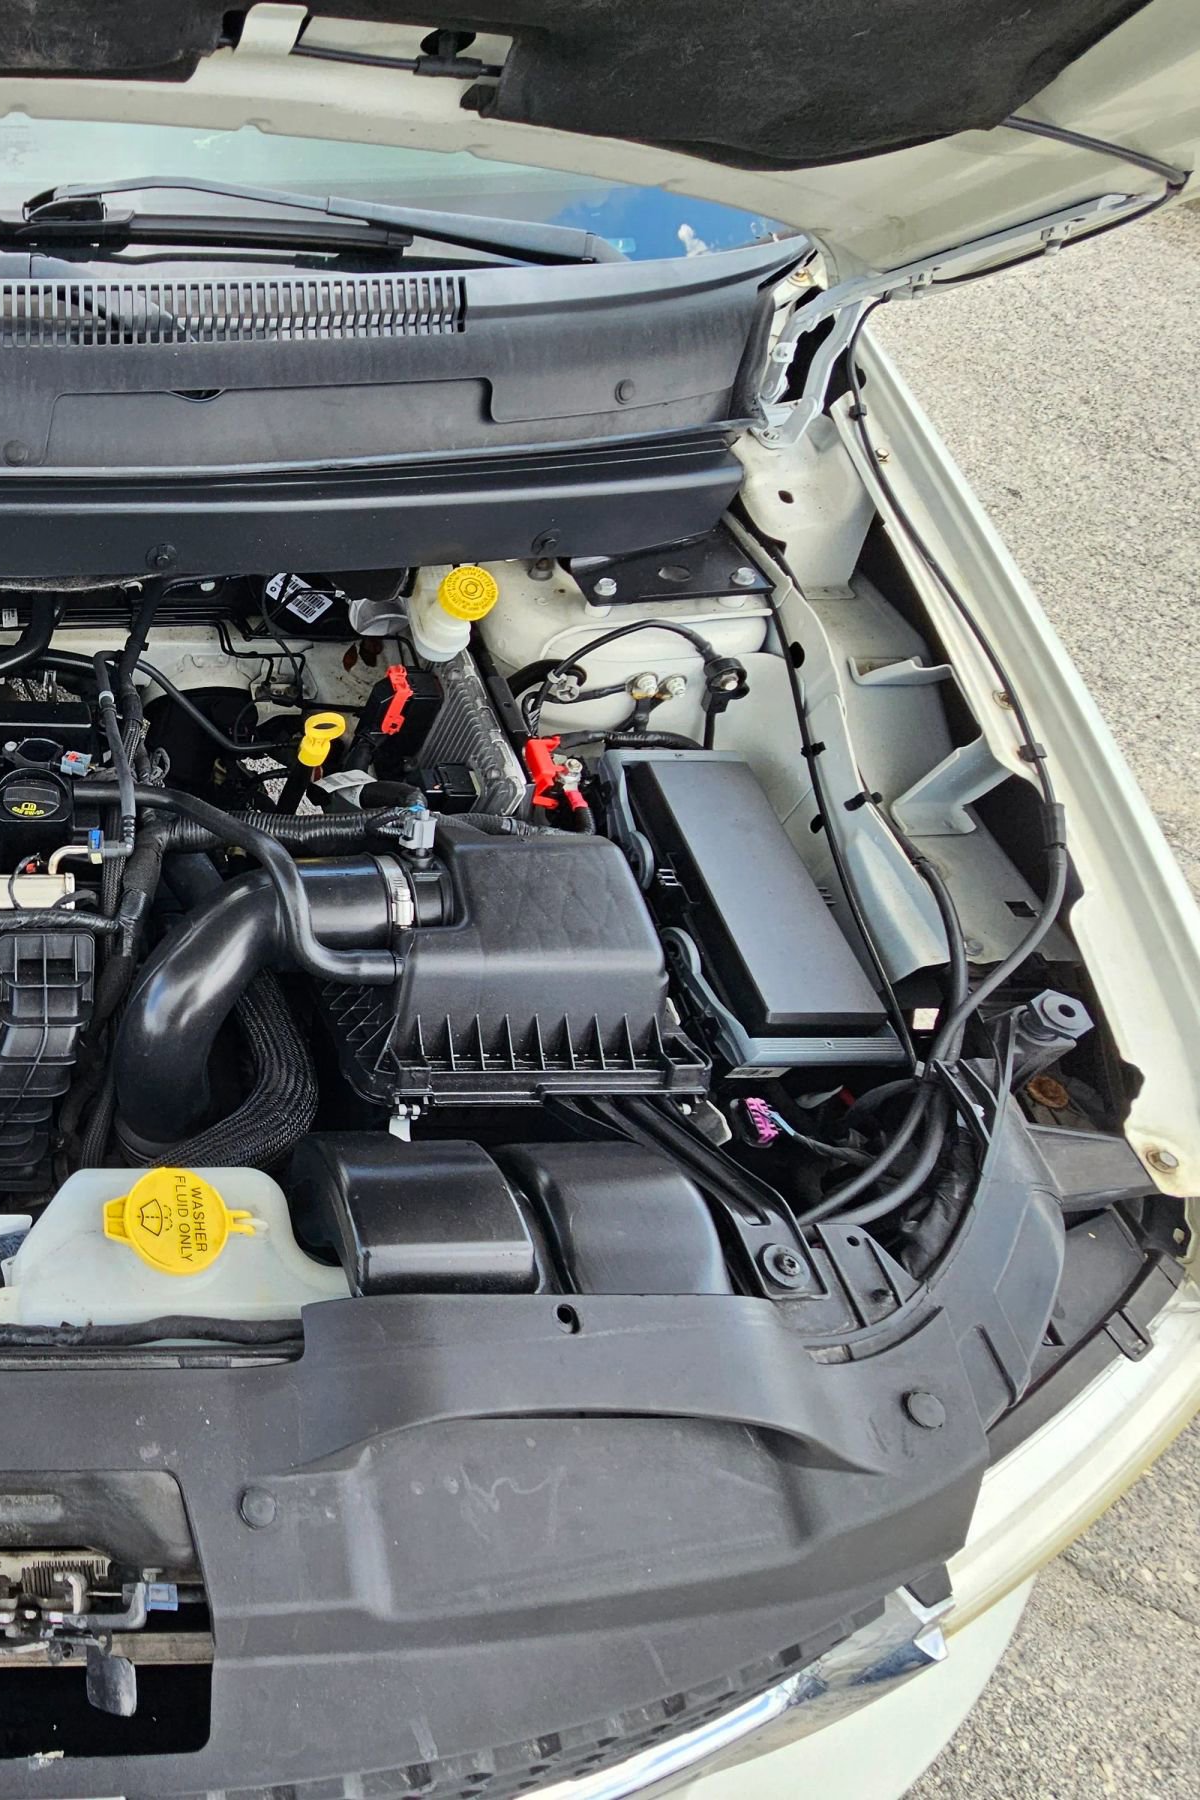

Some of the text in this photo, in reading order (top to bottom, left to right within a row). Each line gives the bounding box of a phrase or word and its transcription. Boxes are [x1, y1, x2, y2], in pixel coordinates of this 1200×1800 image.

[174, 1175, 193, 1263] FLUID ONLY
[191, 1186, 208, 1253] WASHER
